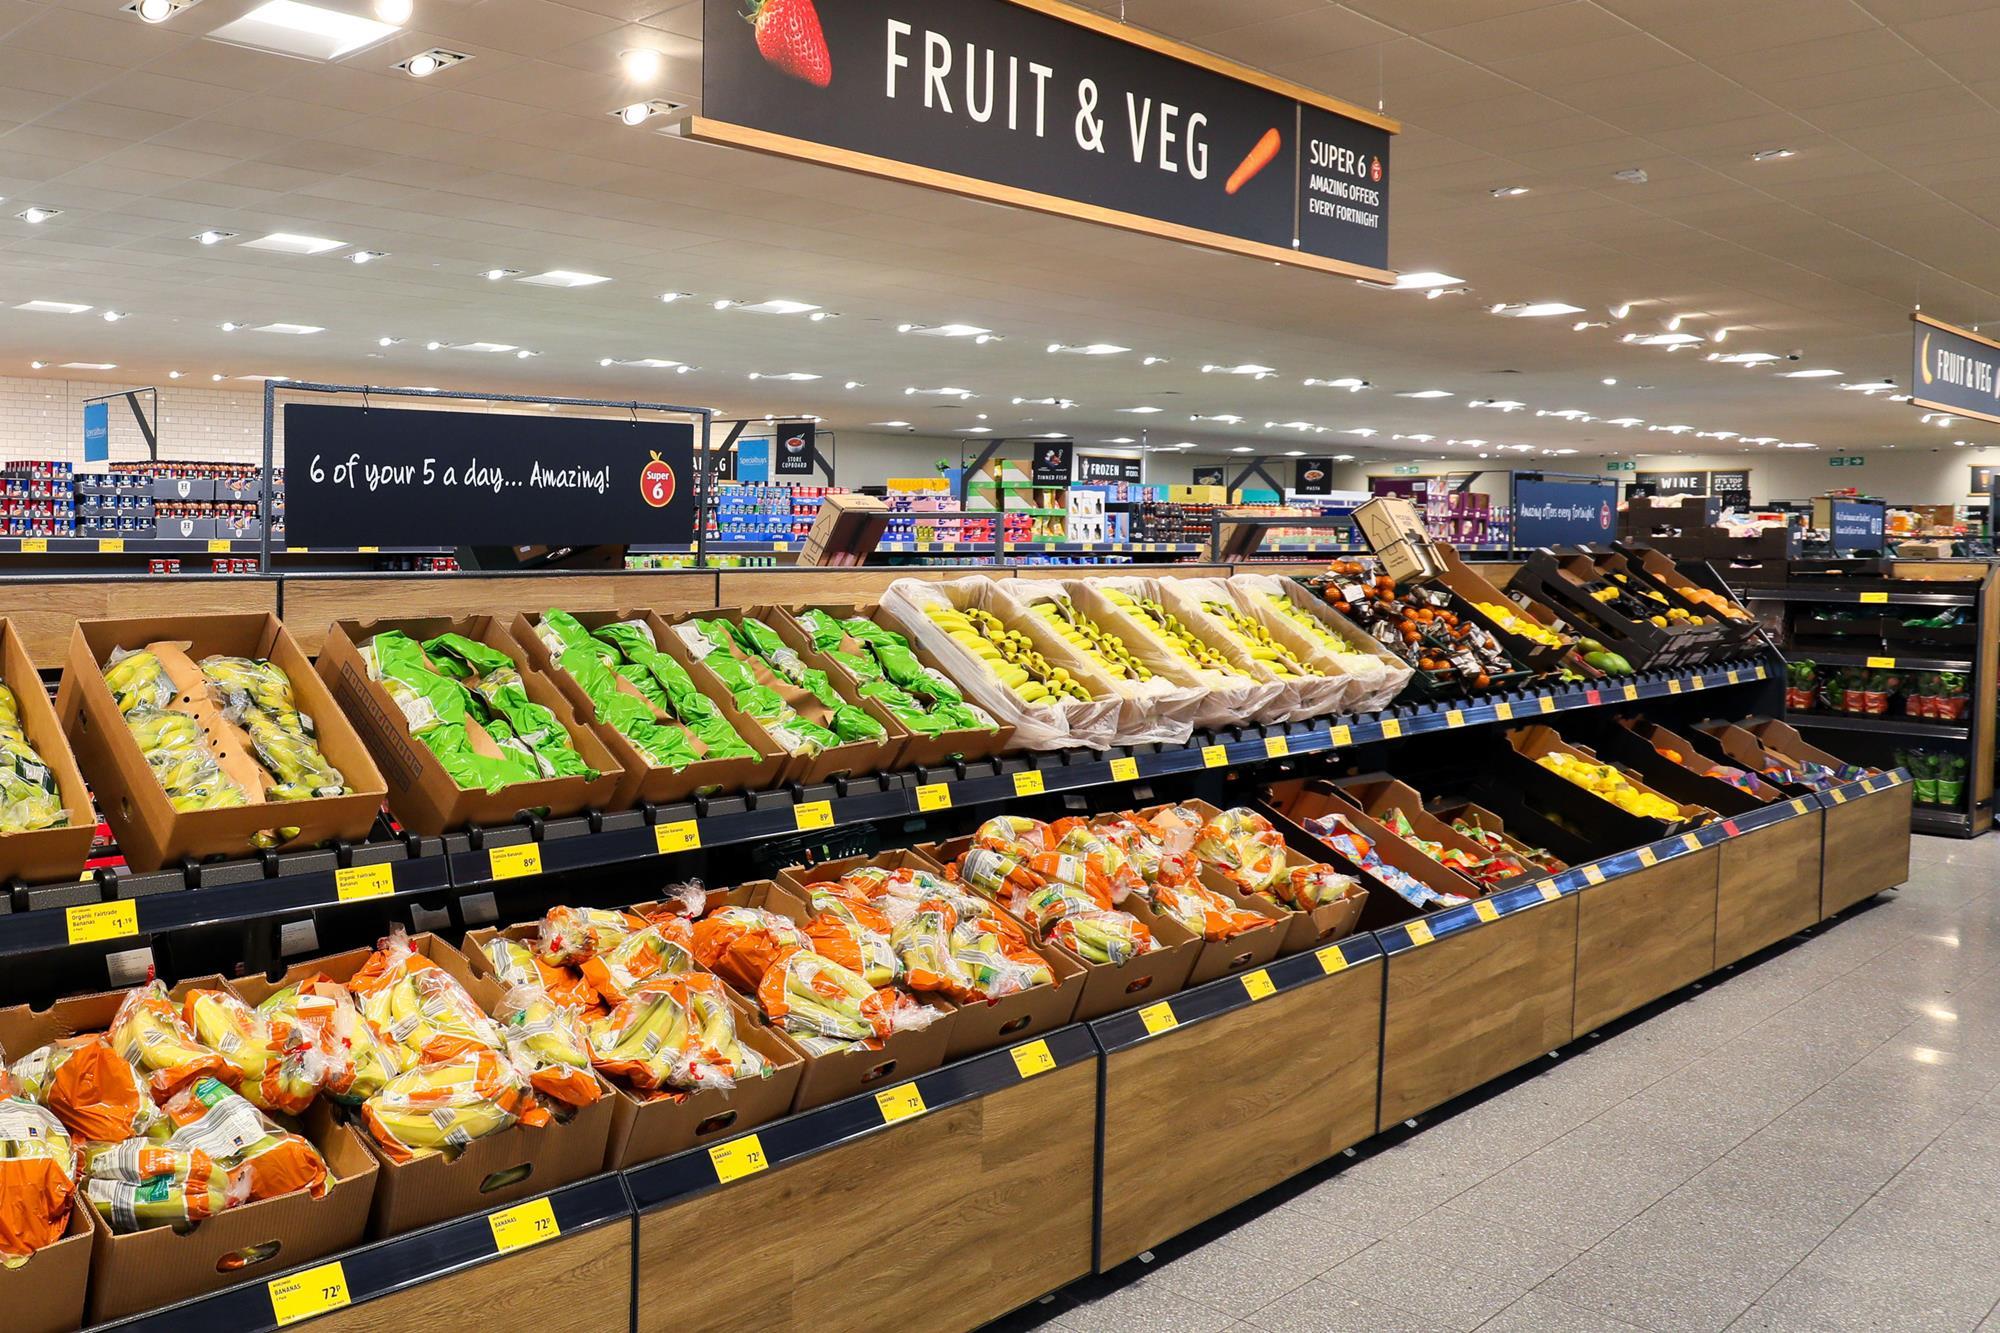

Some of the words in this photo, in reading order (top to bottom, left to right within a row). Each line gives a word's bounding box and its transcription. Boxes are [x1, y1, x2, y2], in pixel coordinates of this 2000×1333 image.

[887, 18, 1053, 138] FRUIT
[1075, 78, 1105, 154] &
[1126, 92, 1208, 180] VEG
[1310, 139, 1355, 175] SUPER
[1358, 154, 1366, 178] 6
[1309, 174, 1348, 199] AMAZING
[1349, 184, 1379, 206] OFFERS
[1309, 198, 1335, 218] EVERY
[1336, 205, 1379, 228] FORTNIGHT
[1937, 349, 1965, 386] FRUIT
[1966, 358, 1973, 388] &
[1975, 361, 1992, 393] VEG
[310, 454, 325, 483] 6
[333, 453, 360, 488] of
[365, 464, 416, 492] your
[423, 458, 436, 485] 5
[443, 466, 458, 486] a
[464, 457, 523, 494] day...
[530, 460, 610, 495] Amazing!
[646, 470, 670, 482] Super
[1091, 463, 1120, 476] FROZEN
[652, 482, 665, 500] 6
[1660, 477, 1698, 489] WINE
[1521, 503, 1541, 520] Amazing
[1542, 503, 1557, 520] offers
[1558, 507, 1571, 521] every
[71, 913, 92, 921] Organic
[93, 909, 118, 917] Fairtrade
[112, 917, 133, 929] £1.19
[495, 1217, 517, 1228] BANANAS
[275, 1283, 301, 1296] BANANAS
